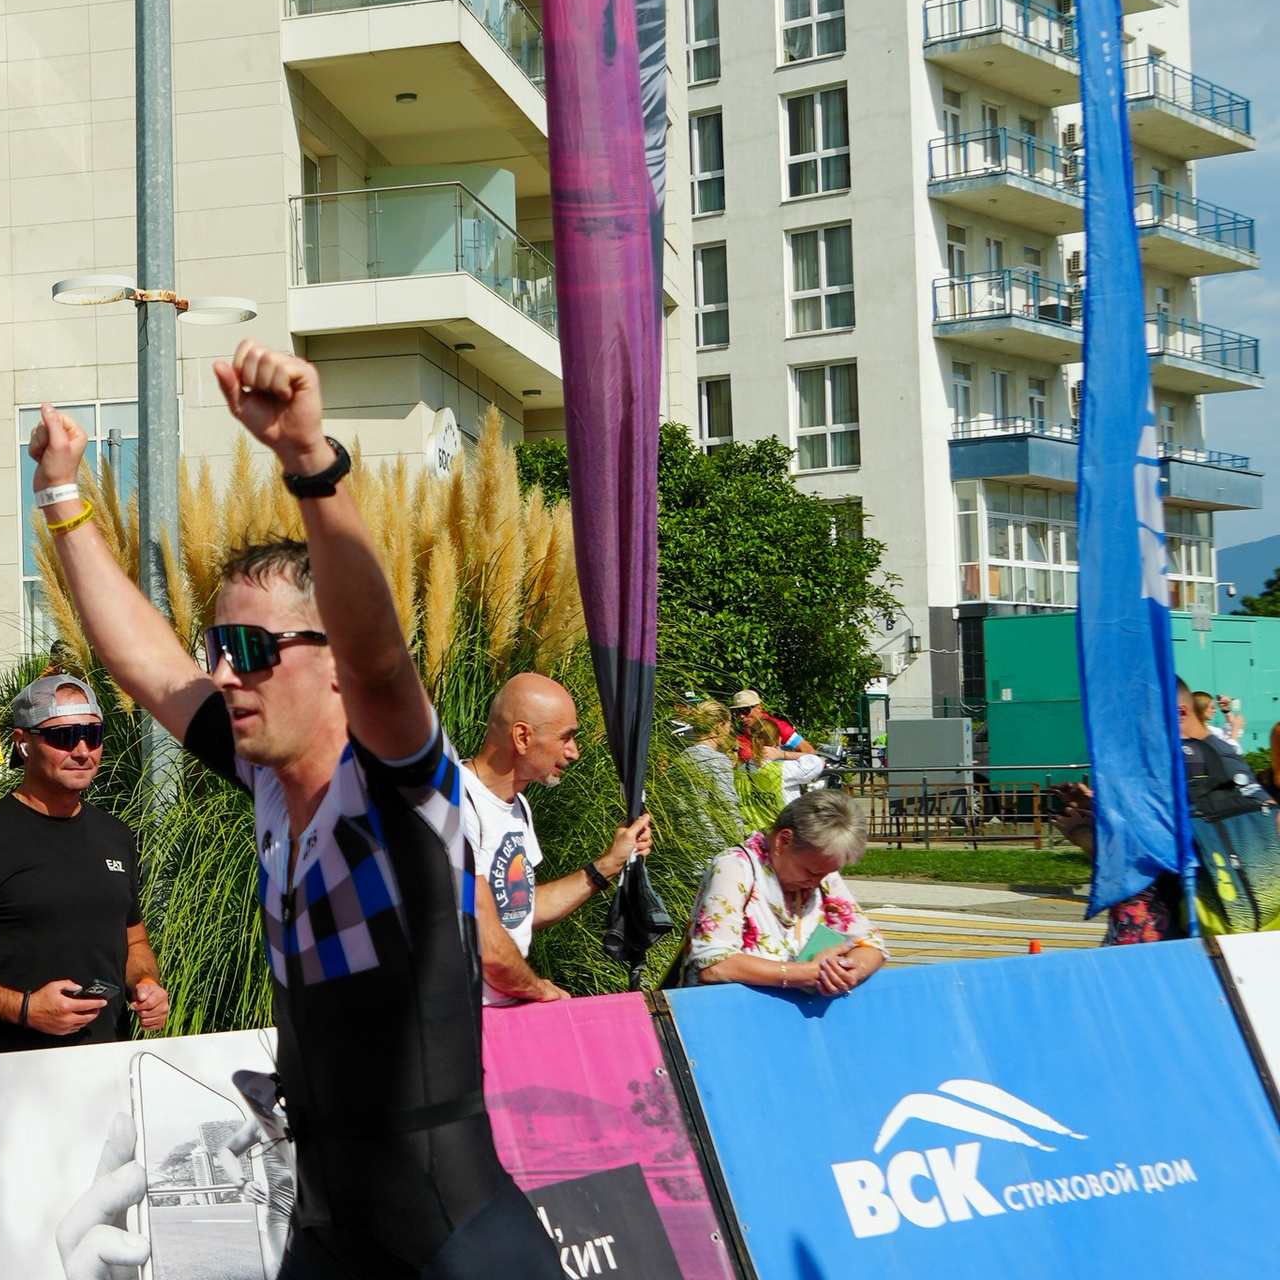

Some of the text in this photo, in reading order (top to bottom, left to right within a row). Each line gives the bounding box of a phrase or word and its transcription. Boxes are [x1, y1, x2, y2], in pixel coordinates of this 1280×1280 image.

[831, 1142, 1198, 1238] ВСК СТРАХОВОЙ ДОМ
